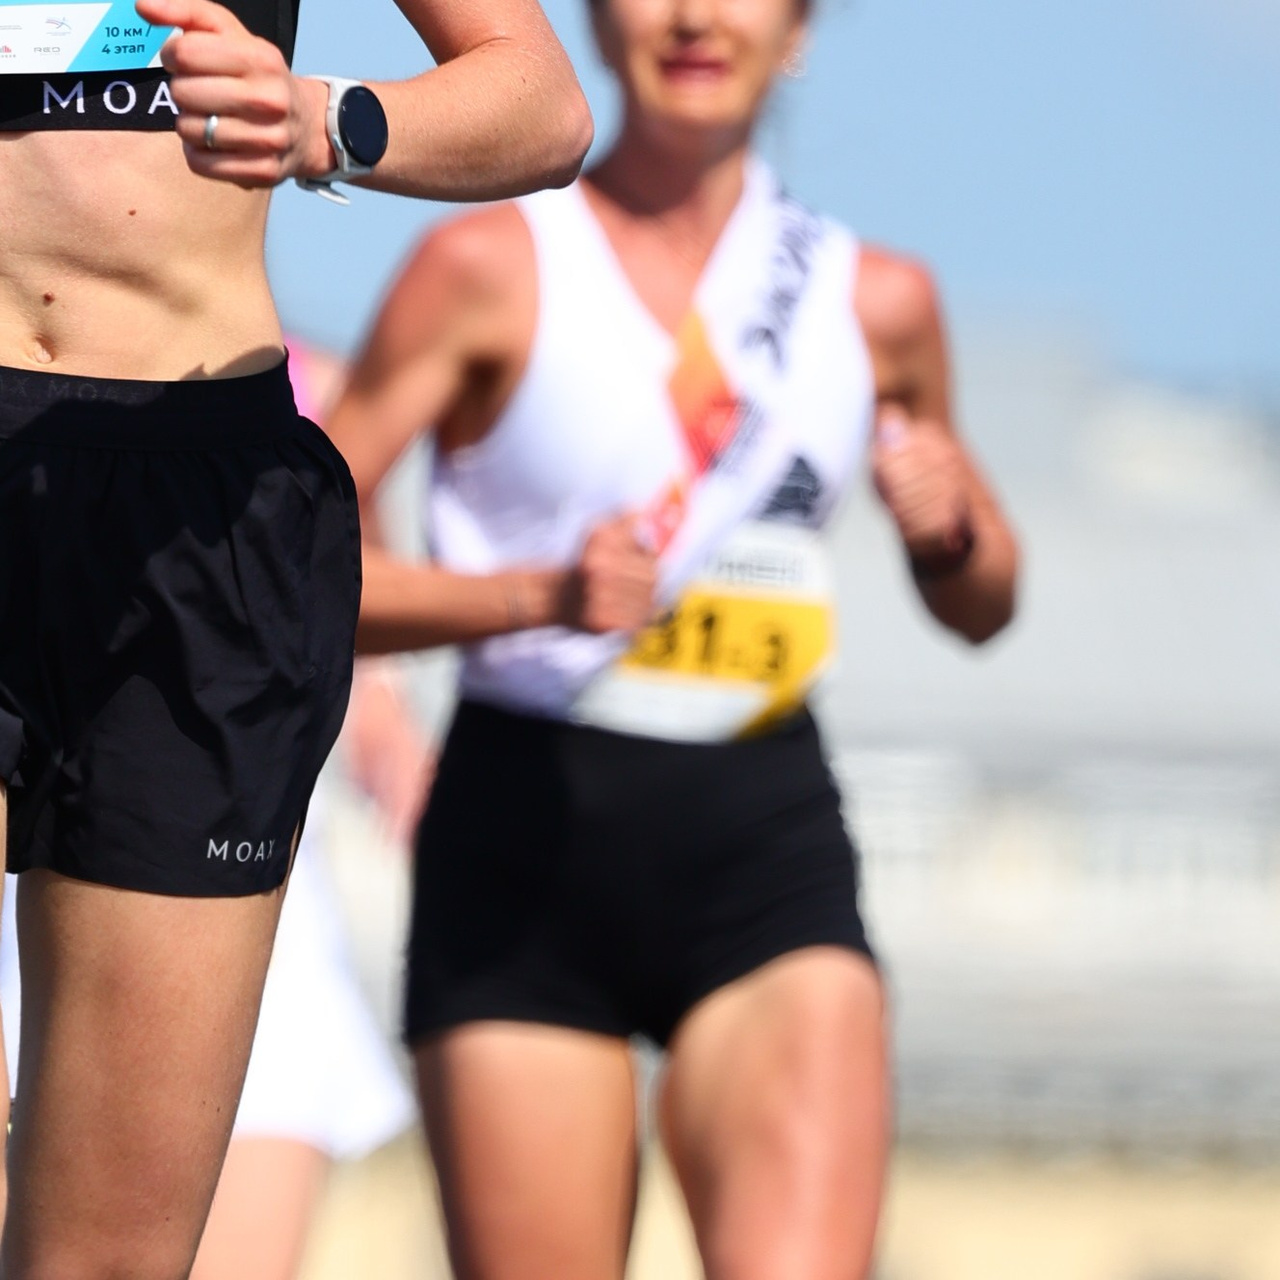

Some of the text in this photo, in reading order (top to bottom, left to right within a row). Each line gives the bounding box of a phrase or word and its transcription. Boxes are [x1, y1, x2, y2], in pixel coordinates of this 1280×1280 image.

[105, 26, 120, 38] 10
[124, 28, 142, 38] км
[101, 43, 145, 55] 4 этап
[206, 838, 276, 862] MOAX
